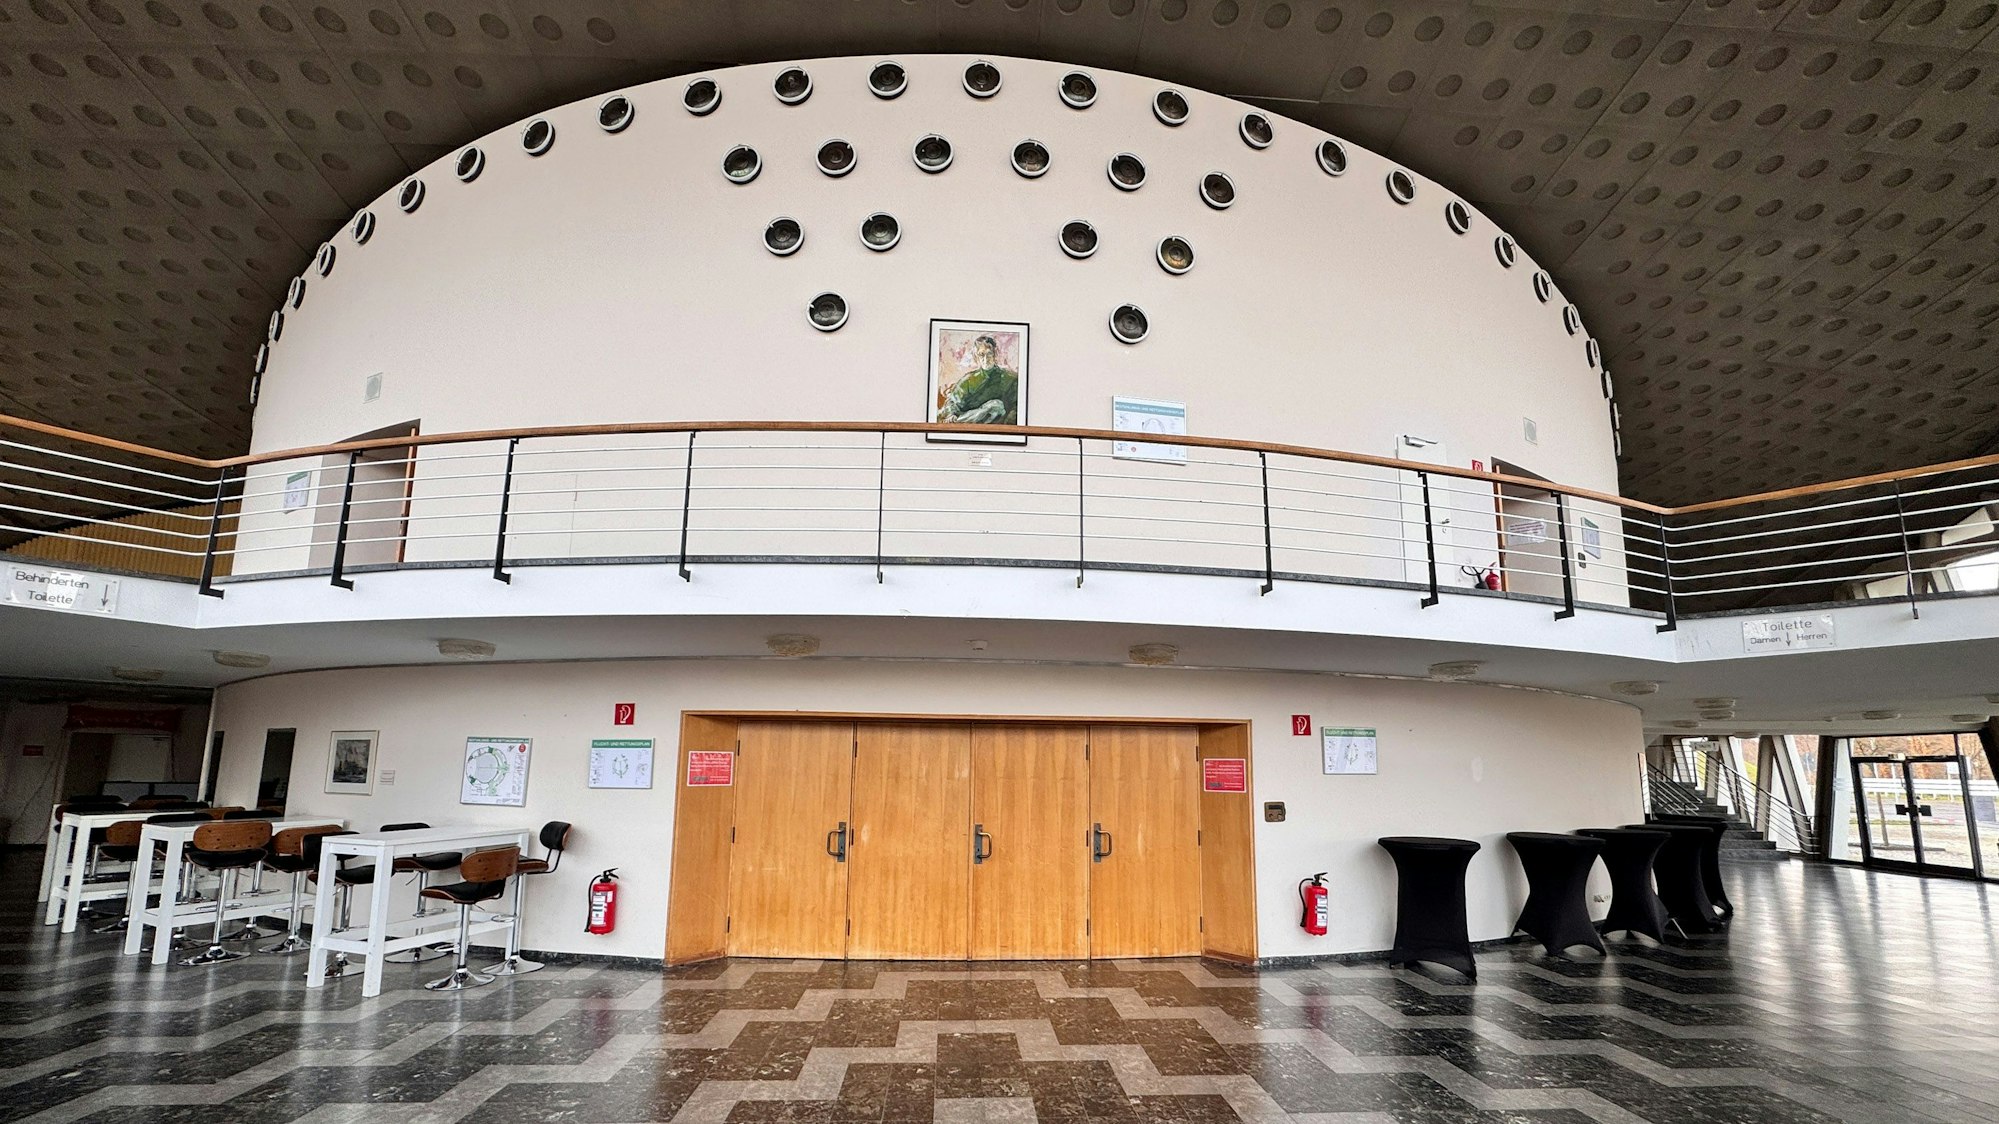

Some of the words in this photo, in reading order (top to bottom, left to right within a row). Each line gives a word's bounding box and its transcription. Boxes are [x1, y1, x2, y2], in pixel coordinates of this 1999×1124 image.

[15, 570, 90, 590] Behinderten
[28, 589, 74, 605] Toilette
[1763, 620, 1813, 632] Toilette
[1750, 635, 1782, 645] Damen
[1796, 632, 1828, 641] Herren
